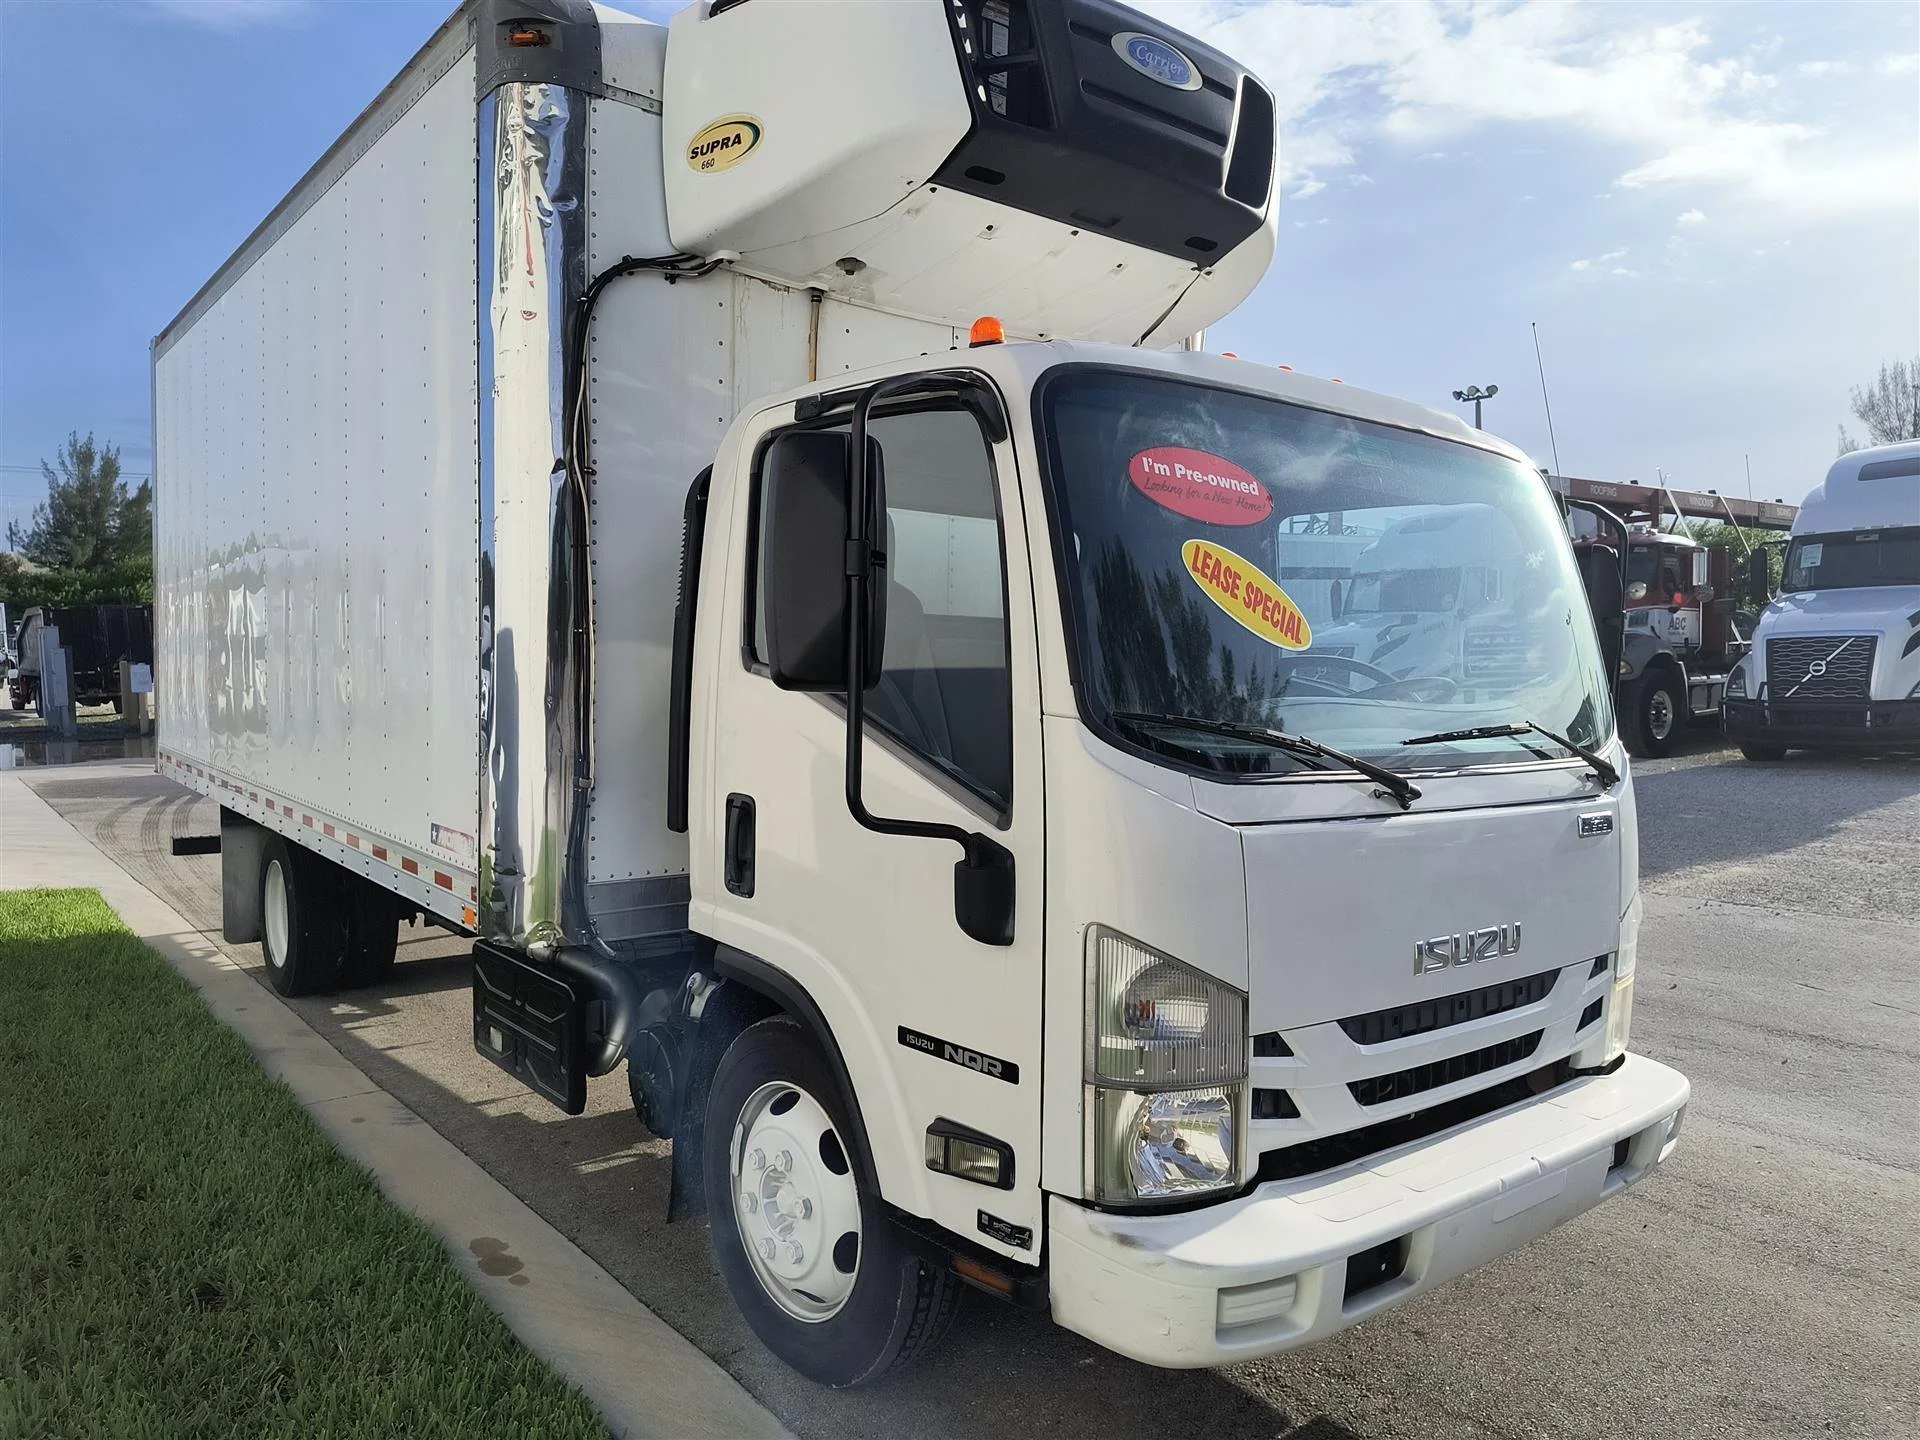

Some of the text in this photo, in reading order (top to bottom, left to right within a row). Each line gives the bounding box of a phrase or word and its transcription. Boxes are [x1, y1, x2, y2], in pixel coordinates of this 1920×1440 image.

[1136, 45, 1184, 74] Carrier
[690, 133, 742, 160] SUPRA
[701, 158, 715, 170] 660
[1142, 457, 1259, 496] I'm Pre-owned
[1590, 484, 1617, 497] ROOFING
[1143, 477, 1182, 497] Looking
[1187, 486, 1200, 499] for
[1203, 492, 1210, 501] a
[1212, 490, 1231, 505] New
[1191, 544, 1302, 645] LEASE SPECIAL
[1668, 616, 1687, 631] ABC
[1413, 921, 1521, 976] ISUZU
[906, 1034, 1002, 1077] ISUZU NQR
